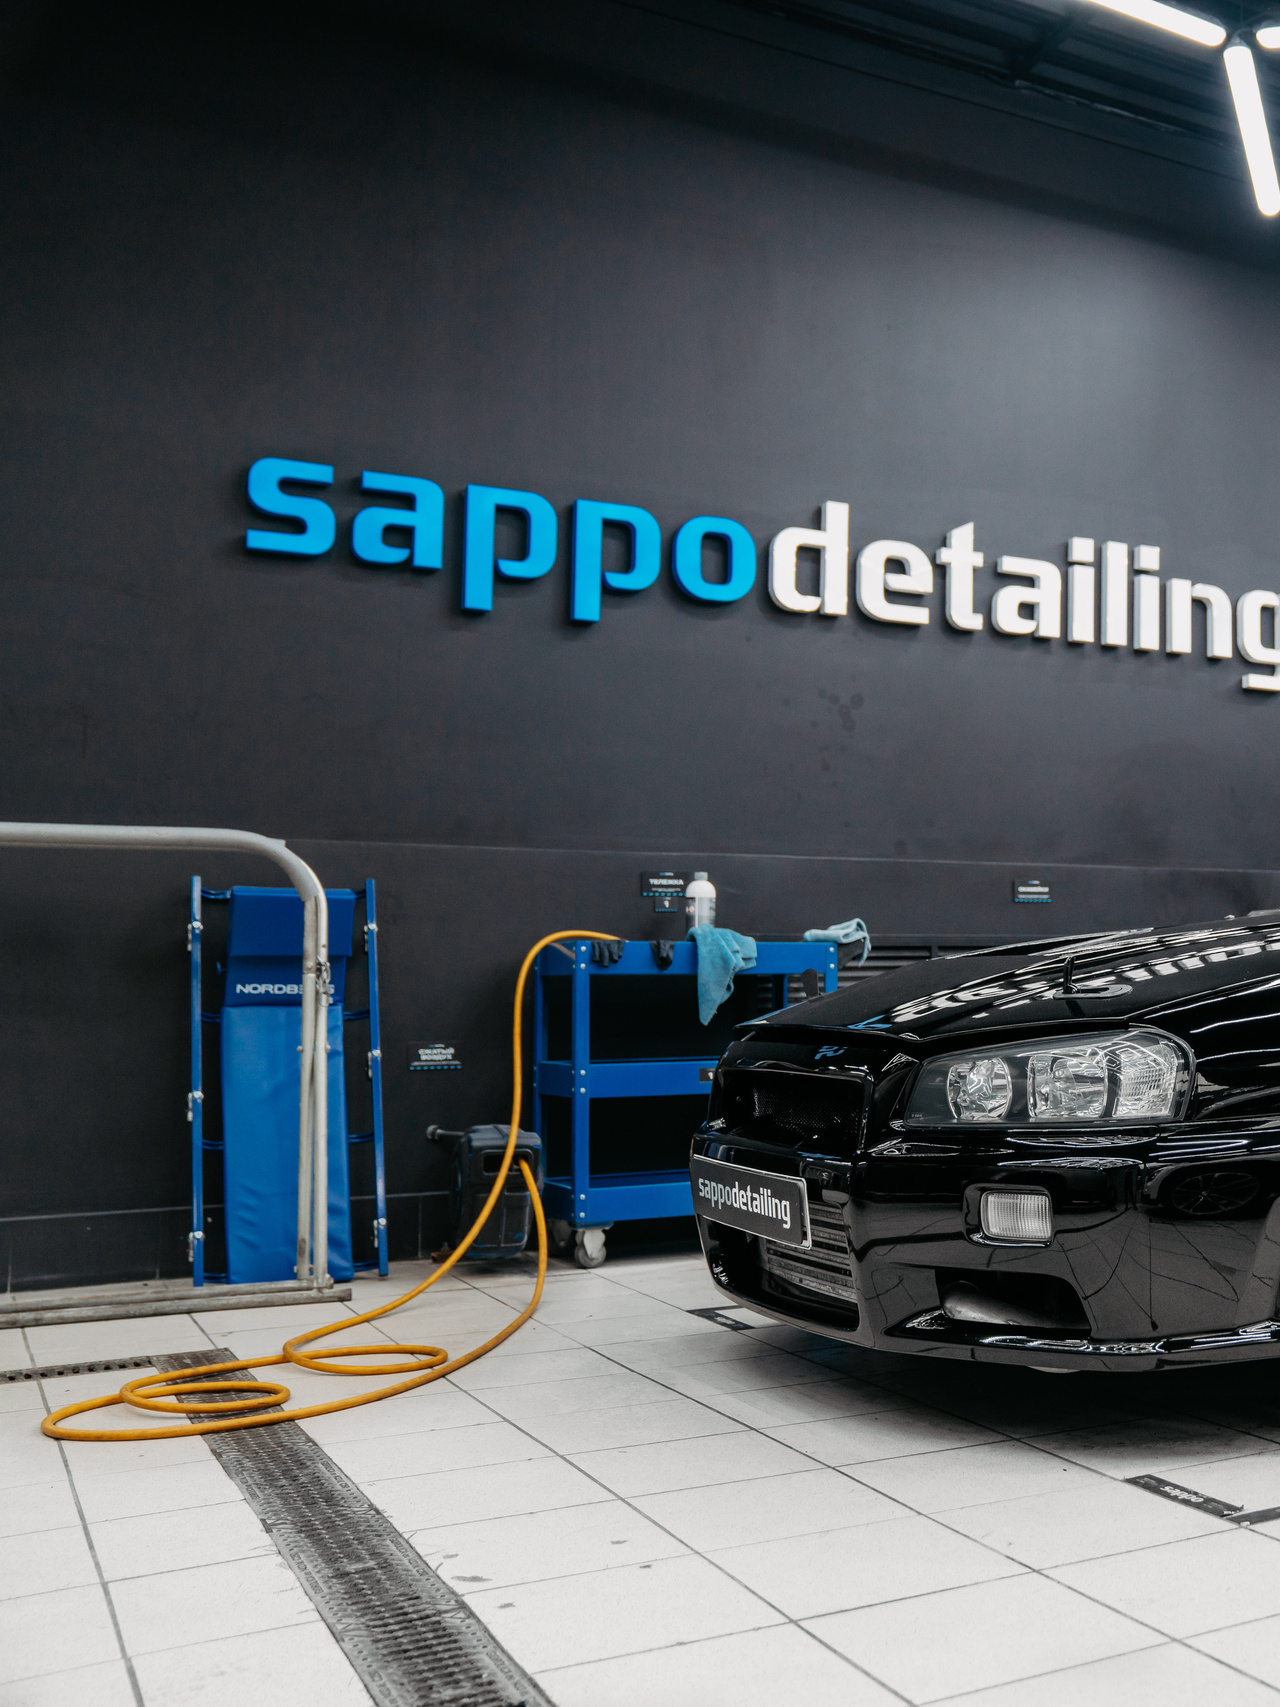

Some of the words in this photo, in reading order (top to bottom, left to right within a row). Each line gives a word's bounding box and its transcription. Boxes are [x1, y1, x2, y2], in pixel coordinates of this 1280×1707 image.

[663, 900, 669, 908] 1
[236, 984, 335, 994] NORDBG
[1160, 1485, 1204, 1503] sappo
